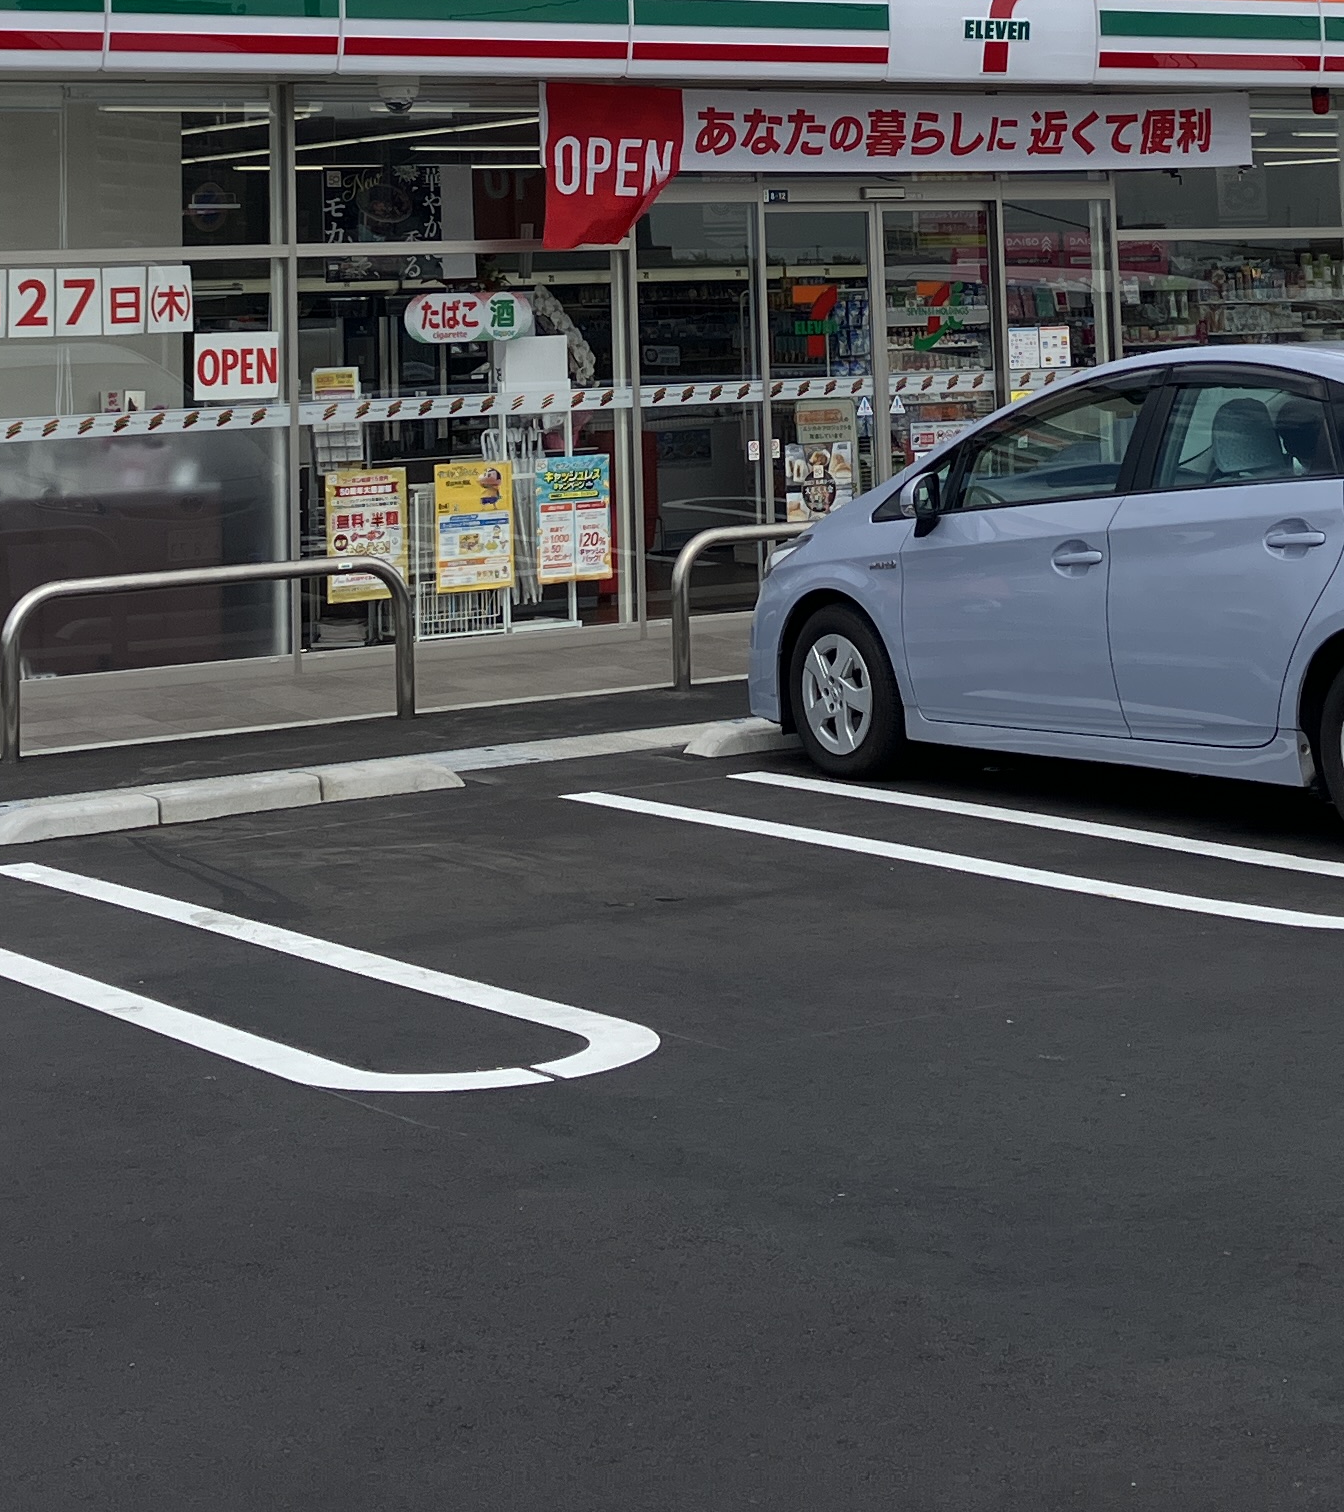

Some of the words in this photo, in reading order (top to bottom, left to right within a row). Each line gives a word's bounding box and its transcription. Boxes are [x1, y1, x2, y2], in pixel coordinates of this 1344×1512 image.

[553, 135, 674, 197] OPEN
[421, 299, 479, 329] たばこ
[490, 299, 514, 327] 酒
[432, 331, 467, 340] cigarette
[196, 347, 278, 387] OPEN
